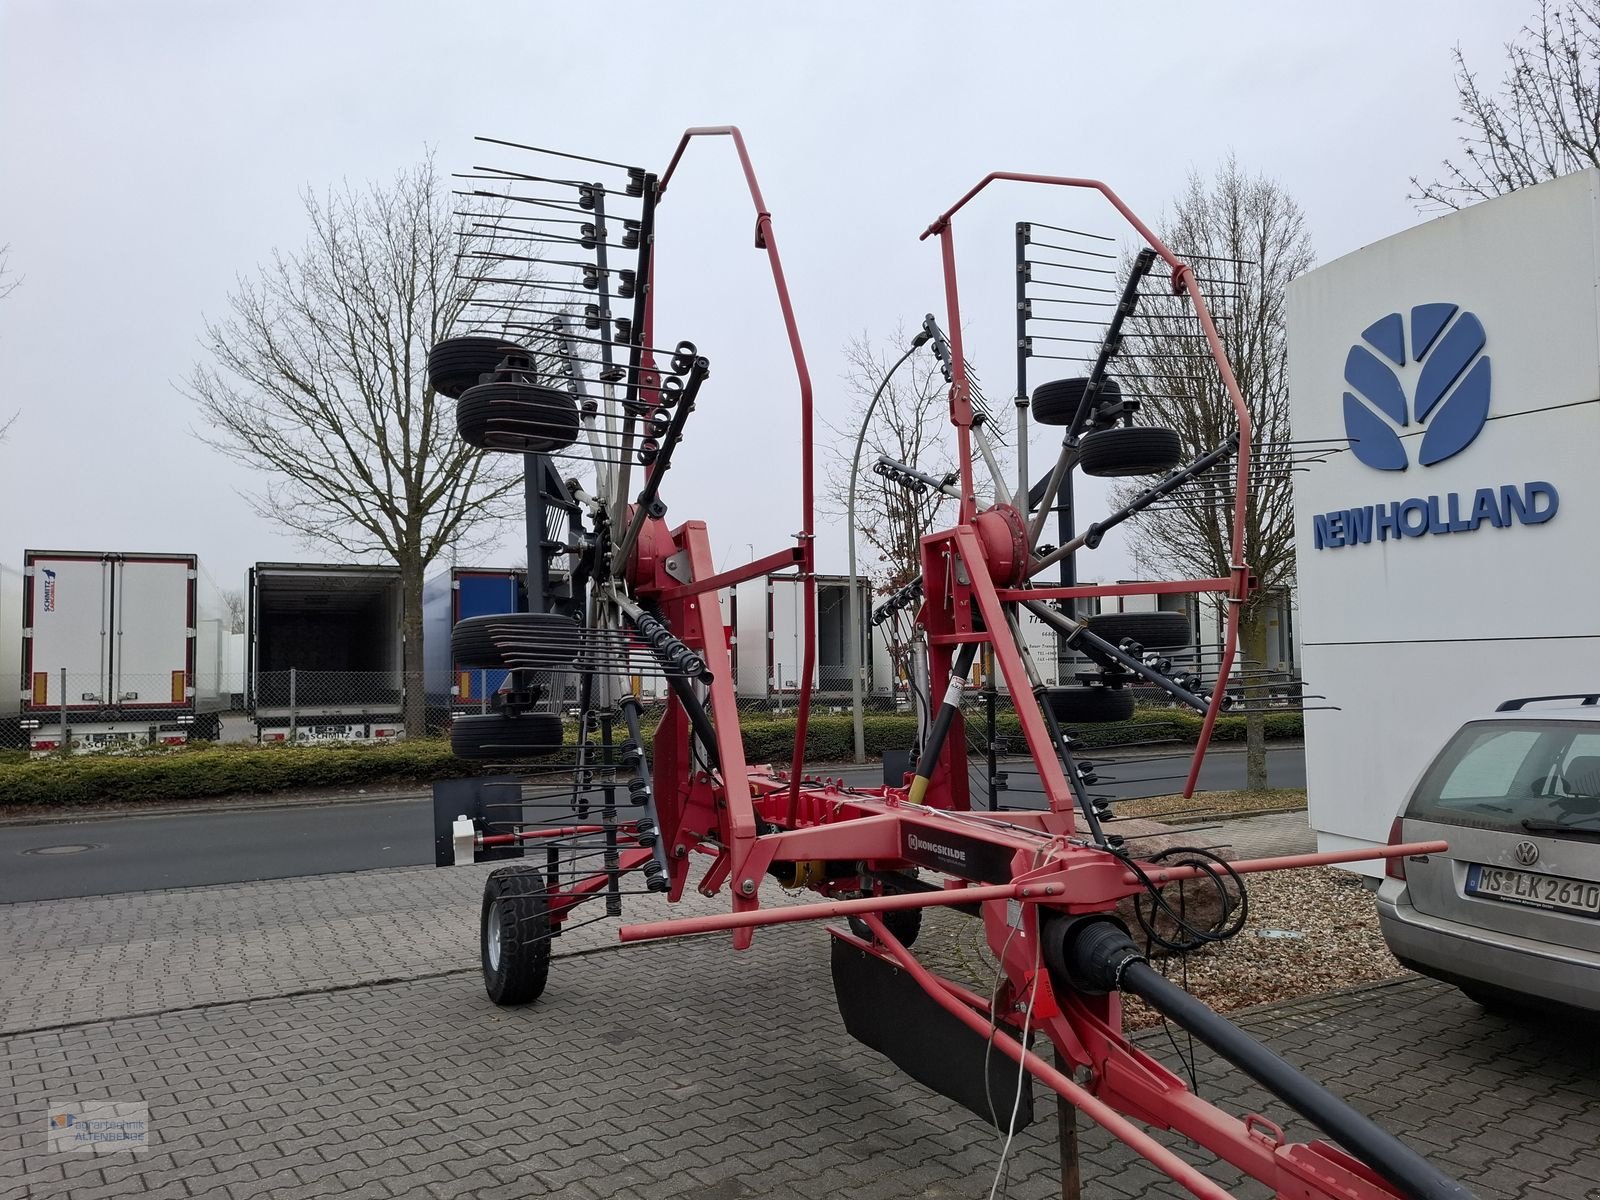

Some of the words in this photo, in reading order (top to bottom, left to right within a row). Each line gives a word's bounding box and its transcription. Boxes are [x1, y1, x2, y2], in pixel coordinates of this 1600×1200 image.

[1313, 506, 1374, 550] NEW
[1375, 481, 1560, 541] HOLLAND
[311, 732, 350, 740] SCHMITZ
[918, 840, 966, 861] KONGSKILDE
[1479, 868, 1503, 892] MS
[1515, 875, 1542, 899] LK
[1545, 880, 1599, 909] 2610
